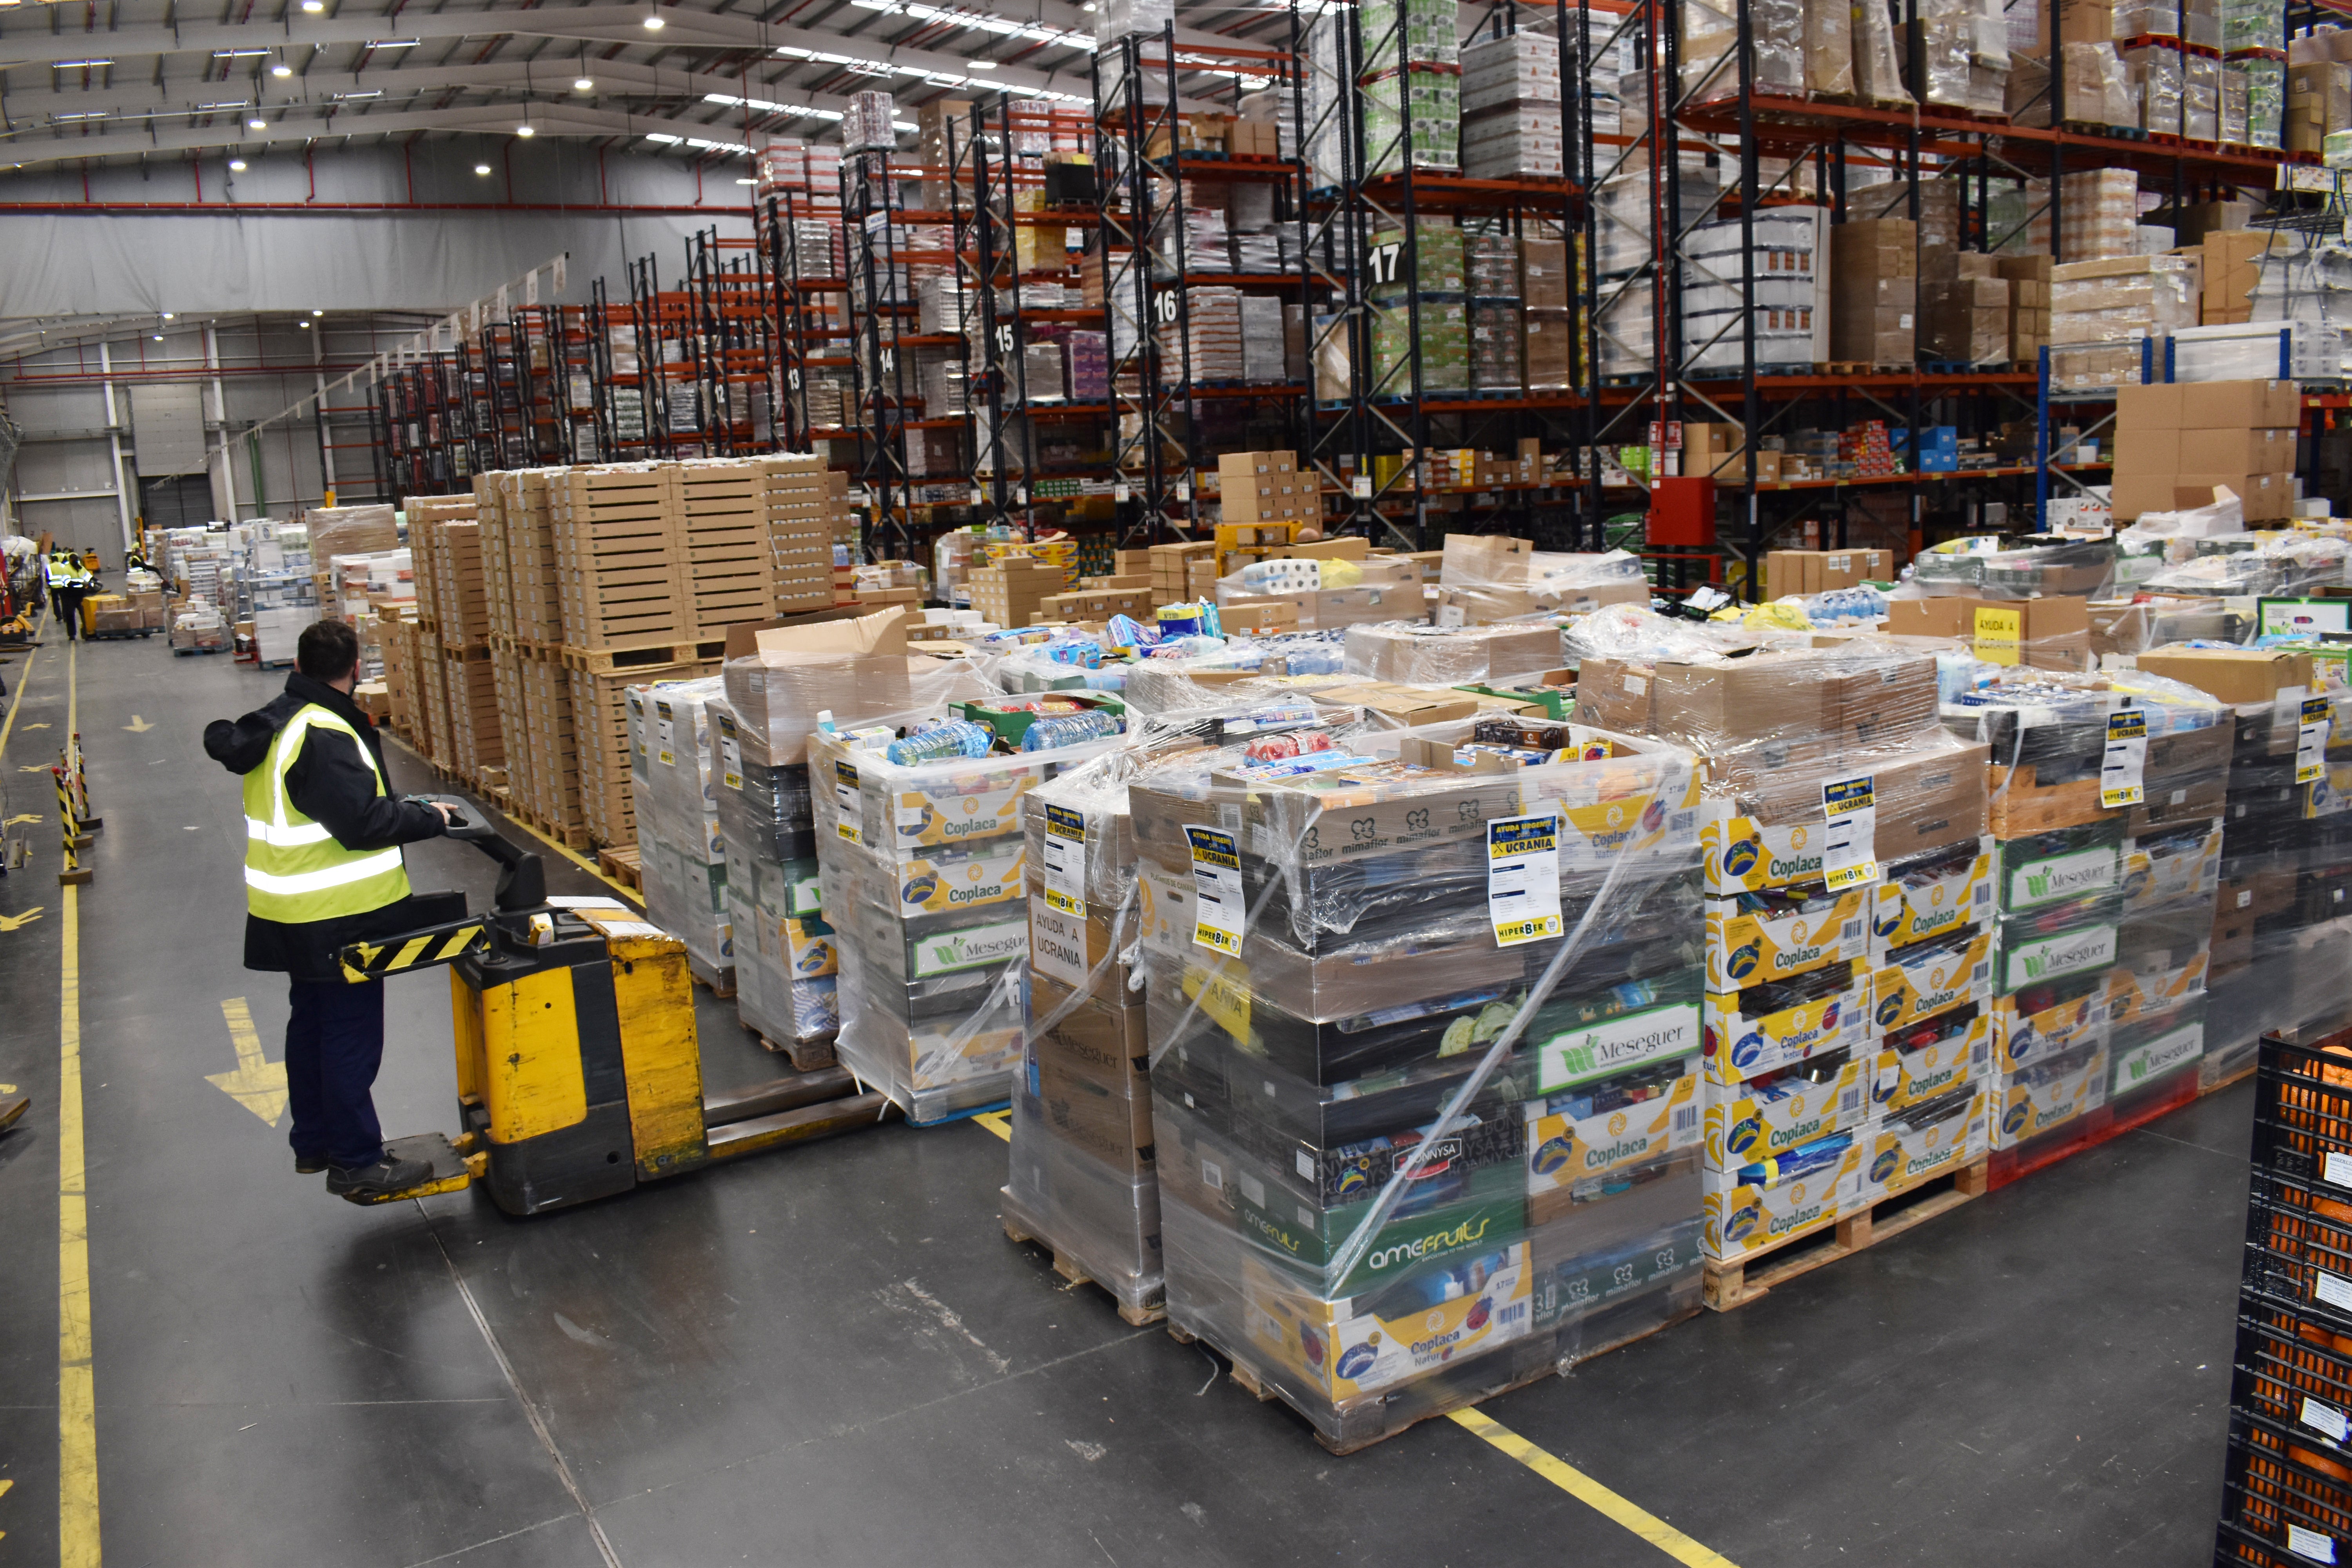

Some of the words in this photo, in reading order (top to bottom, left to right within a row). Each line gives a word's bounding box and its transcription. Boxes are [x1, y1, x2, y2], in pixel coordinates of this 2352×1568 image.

[1368, 243, 1400, 284] 17
[1154, 290, 1176, 322] 16
[995, 325, 1014, 352] 15
[880, 348, 893, 372] 14
[788, 368, 800, 389] 13
[715, 385, 725, 403] 12
[655, 397, 664, 414] 11
[1980, 620, 2004, 631] AYUDA
[2009, 622, 2014, 632] A
[1838, 796, 1871, 810] UCRANIA
[944, 818, 997, 836] Coplaca
[1055, 824, 1082, 838] UCRANIA
[1193, 831, 1210, 840] AYUDA
[1397, 828, 1440, 844] mimaflor
[1496, 825, 1519, 833] AYUDA
[1521, 820, 1552, 830] URGENTE
[1341, 838, 1388, 855] mimaflor
[1506, 838, 1552, 853] UCRANIA
[1202, 850, 1237, 867] UCRANIA
[1771, 855, 1822, 878] Coplaca
[1828, 867, 1863, 884] HIPERBER
[2051, 866, 2105, 889] Meseguer
[949, 885, 1001, 903] Coplaca
[1047, 893, 1073, 909] HIPERBER
[1036, 913, 1065, 936] AYUDA
[1072, 928, 1078, 942] A
[1499, 923, 1543, 938] HIPERBER
[1913, 909, 1955, 933] Coplaca
[1198, 928, 1229, 946] HIPERBER
[1038, 936, 1081, 968] UCRANIA
[1776, 947, 1820, 968] Coplaca
[2049, 943, 2106, 968] Meseguer
[1916, 990, 1954, 1012] Coplaca
[1600, 1025, 1683, 1061] Meseguer
[1780, 1029, 1818, 1049] Coplaca
[1063, 1033, 1117, 1068] Meseguer
[1783, 1049, 1802, 1061] Natur
[1703, 1061, 1717, 1071] tur
[1909, 1069, 1952, 1095] Coplaca
[1771, 1119, 1819, 1146] Coplaca
[1586, 1138, 1647, 1168] Coplaca
[1907, 1148, 1952, 1174] Coplaca
[1770, 1205, 1820, 1234] Coplaca
[1648, 1263, 1683, 1282] mimaflor
[1496, 1280, 1505, 1289] 17
[1605, 1277, 1642, 1297] mimaflor
[1410, 1330, 1460, 1355] Coplaca
[1415, 1354, 1440, 1367] Natur
